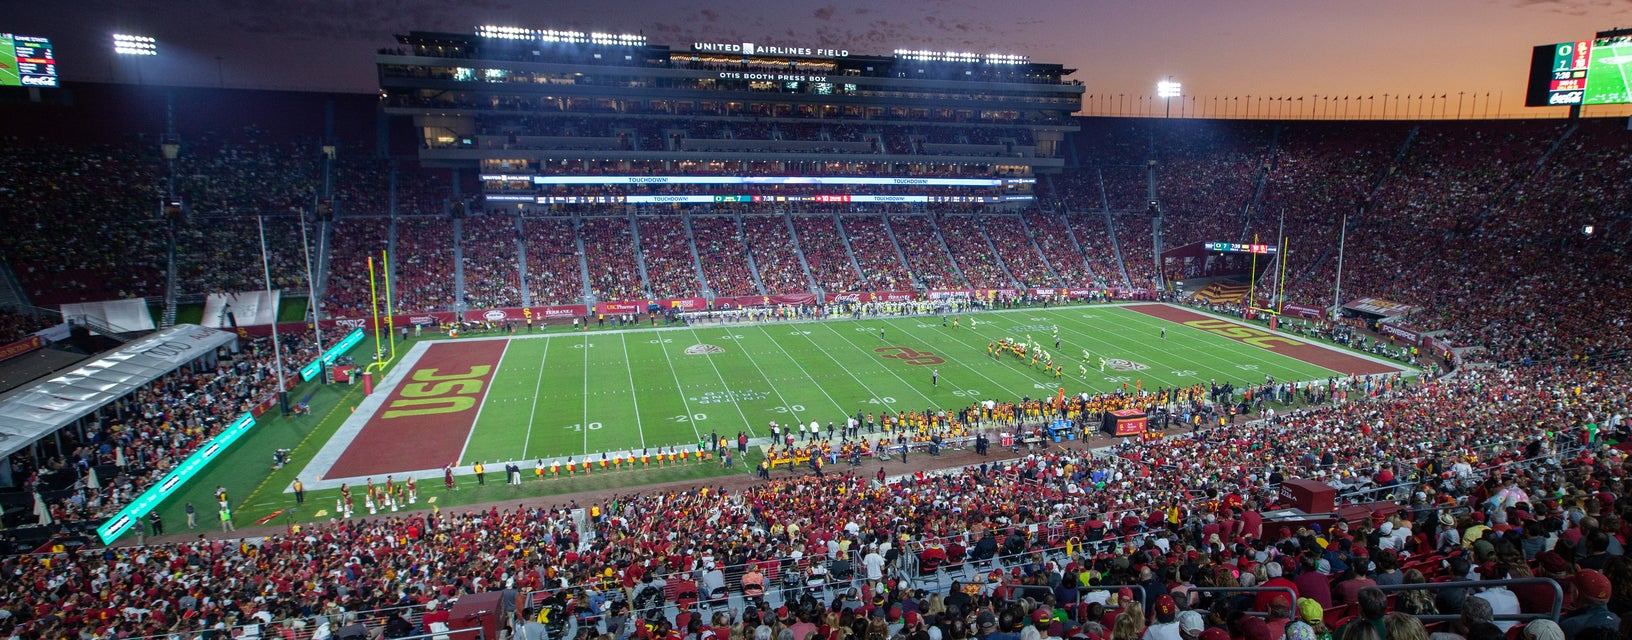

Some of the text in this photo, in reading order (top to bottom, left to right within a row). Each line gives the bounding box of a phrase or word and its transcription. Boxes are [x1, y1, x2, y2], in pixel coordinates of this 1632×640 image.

[695, 42, 849, 57] UNITED AIRLINES FIELD
[1560, 60, 1567, 68] 7
[1183, 319, 1305, 349] USC
[381, 365, 492, 419] USC
[952, 389, 981, 398] 50
[867, 396, 897, 405] 40
[773, 404, 806, 414] 30
[674, 413, 708, 423] 20
[572, 422, 603, 432] 10
